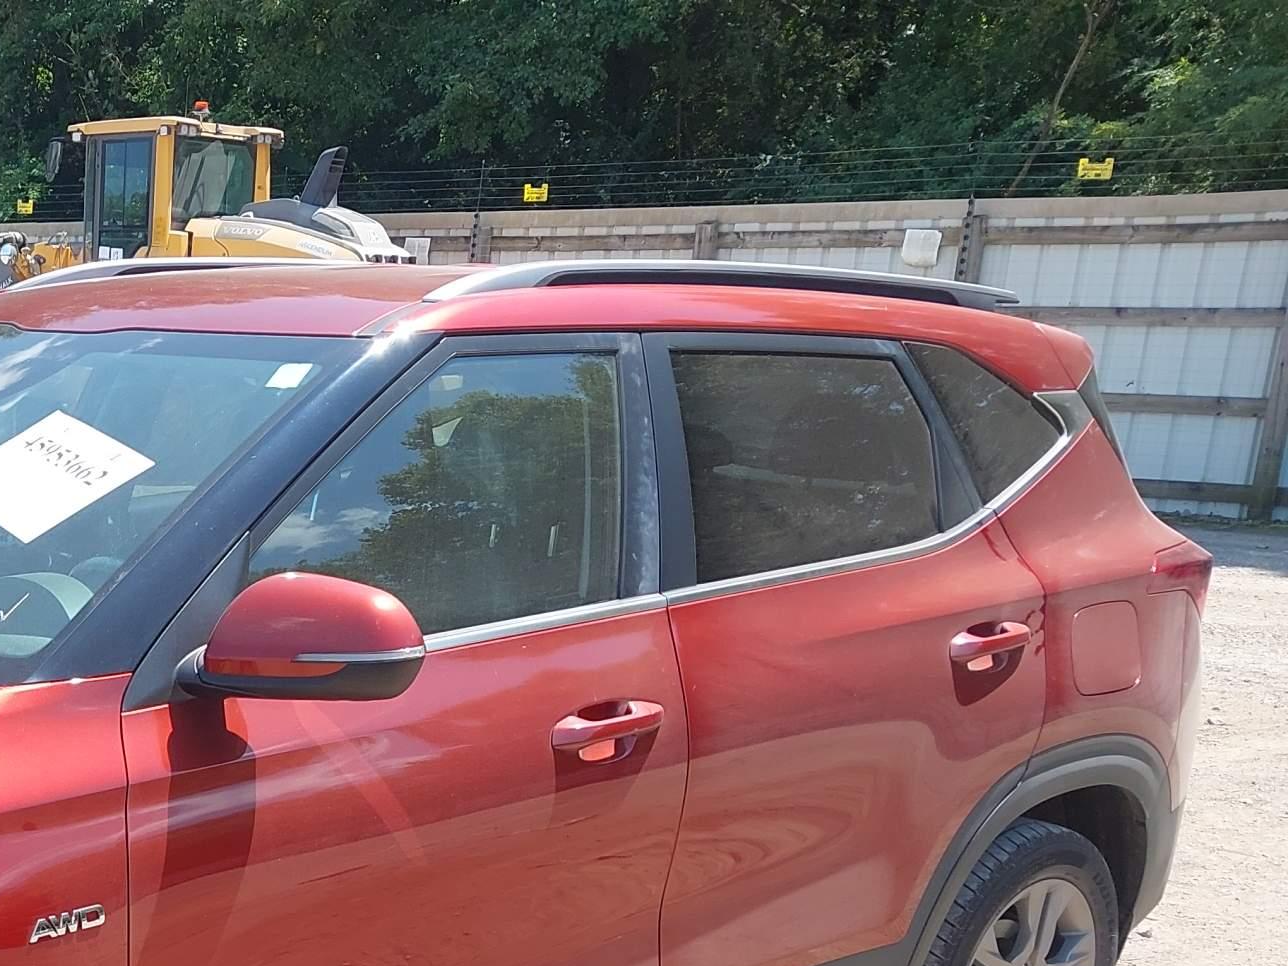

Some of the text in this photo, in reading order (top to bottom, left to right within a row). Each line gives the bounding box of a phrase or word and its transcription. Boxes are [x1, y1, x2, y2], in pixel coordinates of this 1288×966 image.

[223, 224, 264, 236] VOLVO
[23, 435, 110, 488] 45953662
[28, 903, 106, 945] AWD
